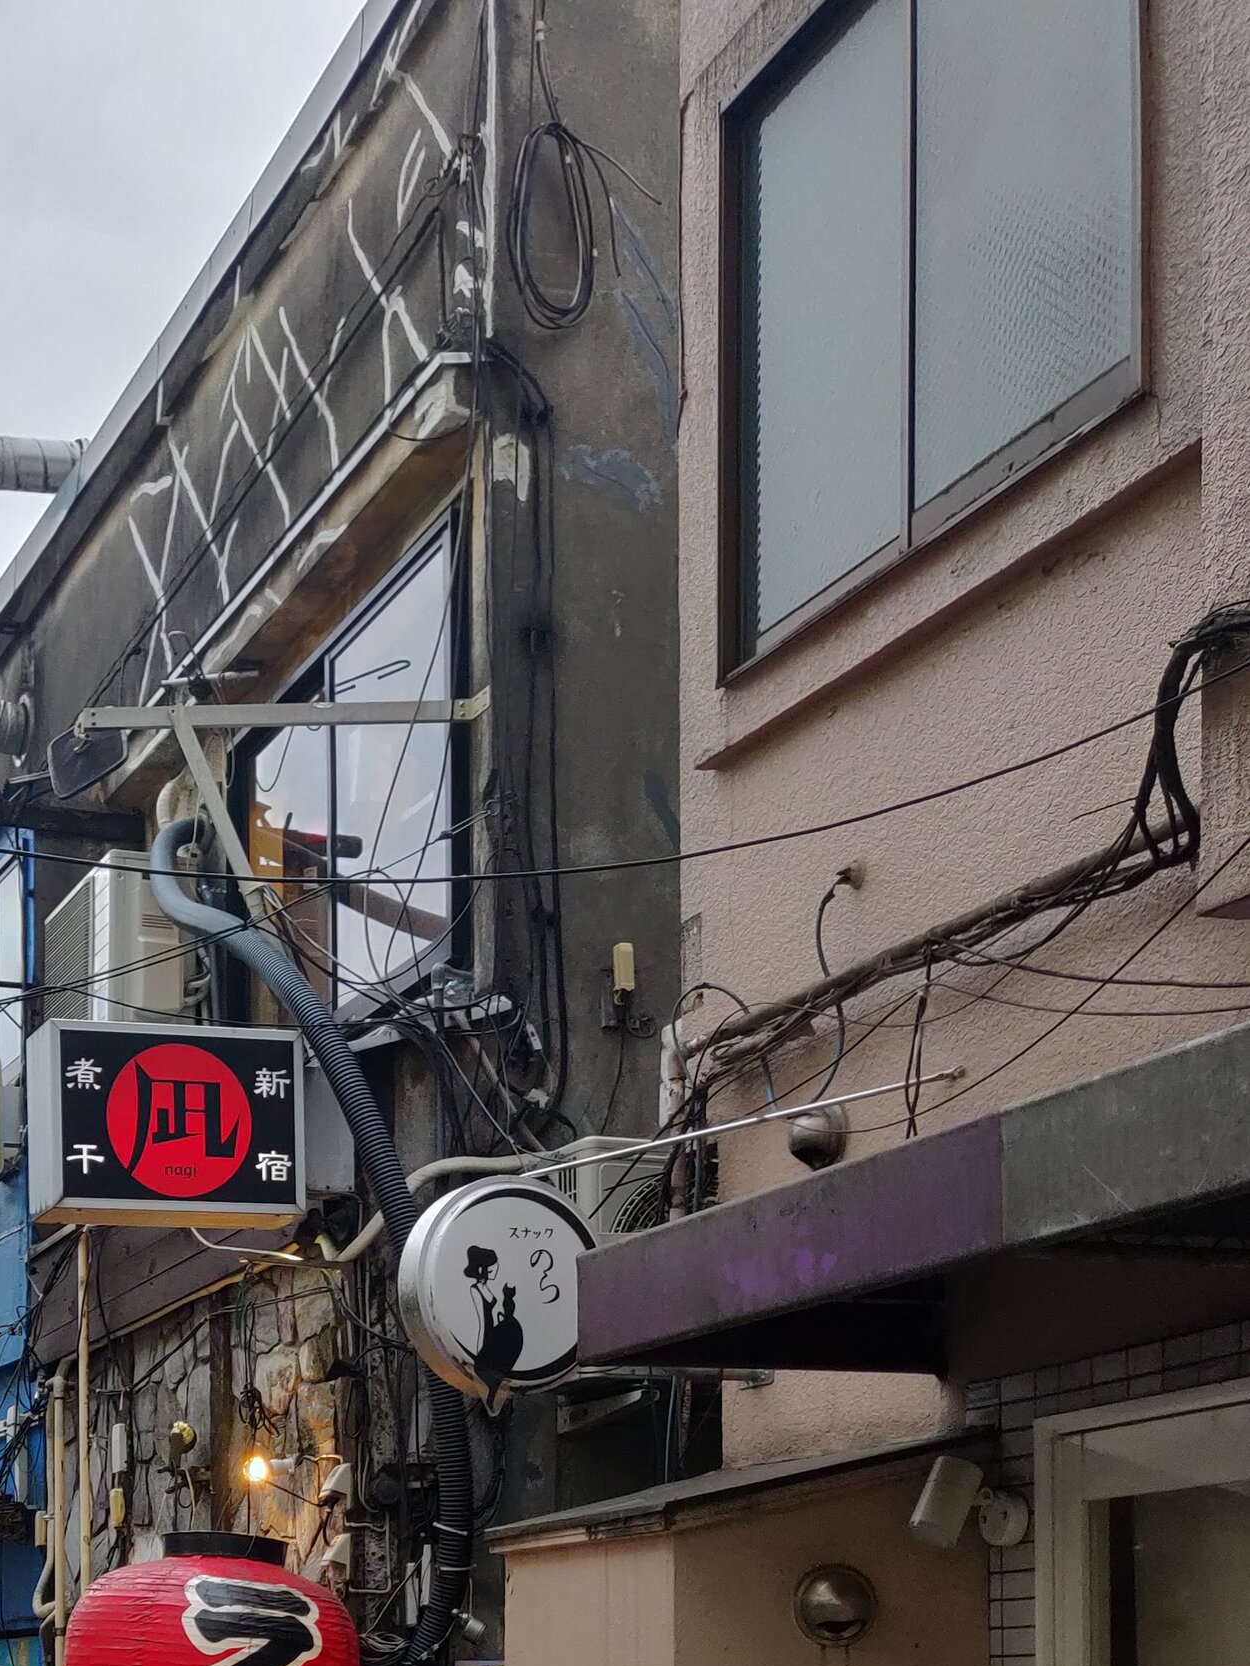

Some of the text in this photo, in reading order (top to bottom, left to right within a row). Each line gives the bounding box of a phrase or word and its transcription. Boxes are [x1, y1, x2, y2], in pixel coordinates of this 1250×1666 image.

[127, 1058, 241, 1176] 凪
[164, 1163, 198, 1179] nagi
[508, 1227, 554, 1239] スナック
[530, 1249, 560, 1304] のら
